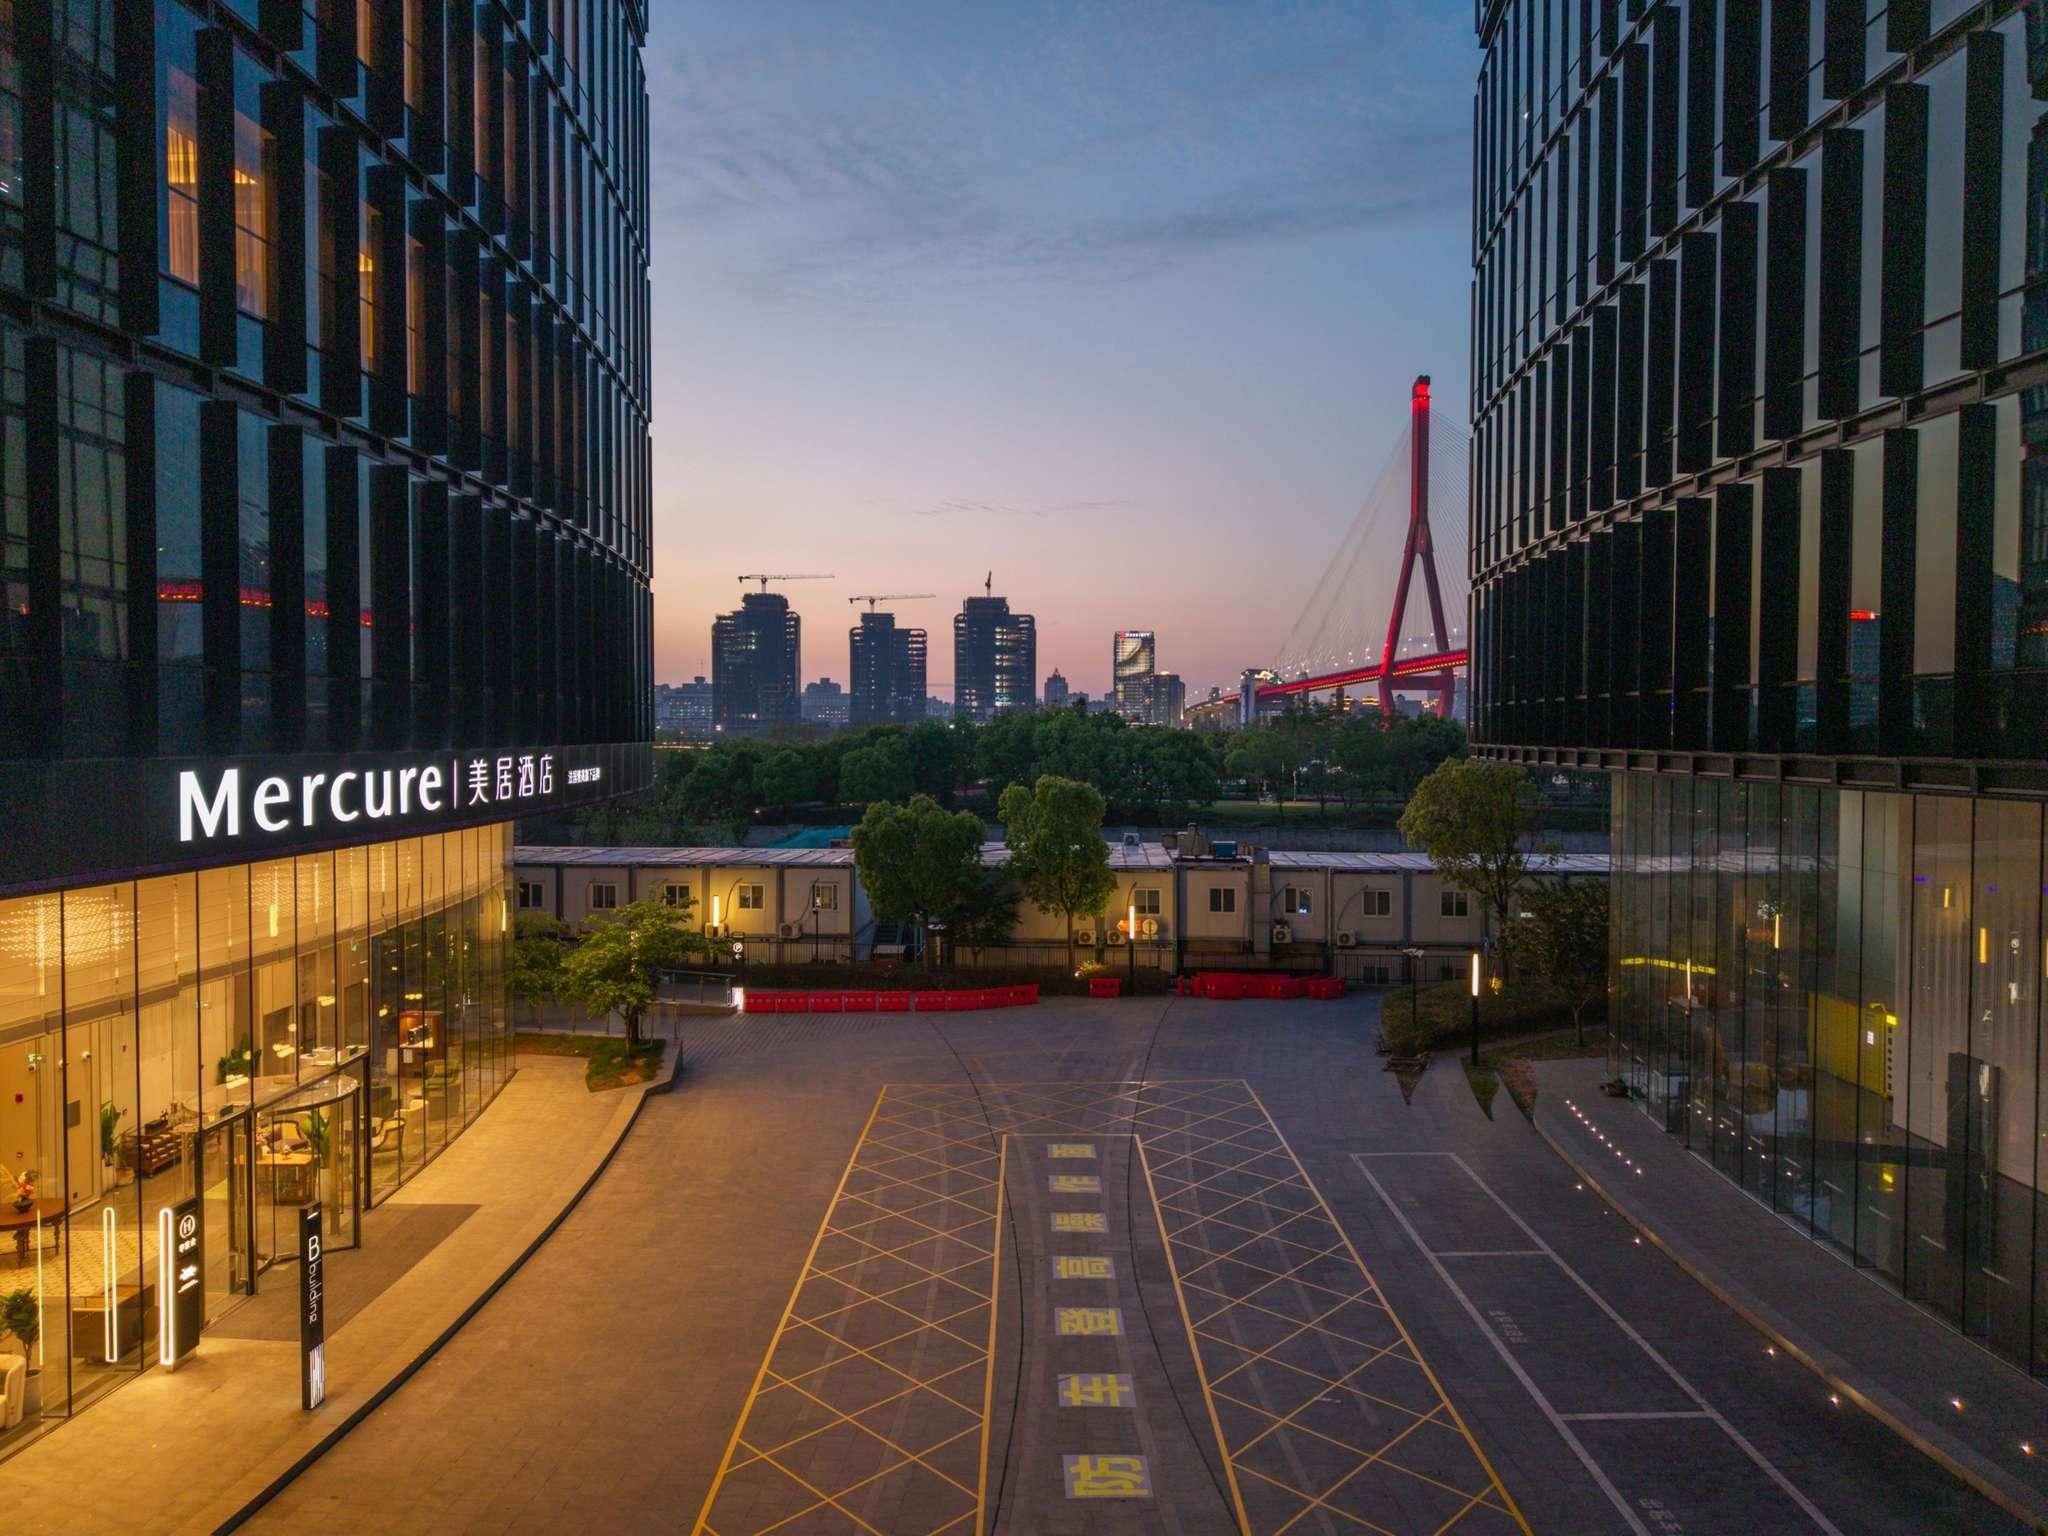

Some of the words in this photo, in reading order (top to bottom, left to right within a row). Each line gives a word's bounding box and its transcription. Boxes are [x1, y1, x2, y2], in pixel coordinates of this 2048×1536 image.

[180, 766, 442, 842] Mercure
[468, 754, 553, 806] 美居酒店
[308, 1235, 320, 1262] B
